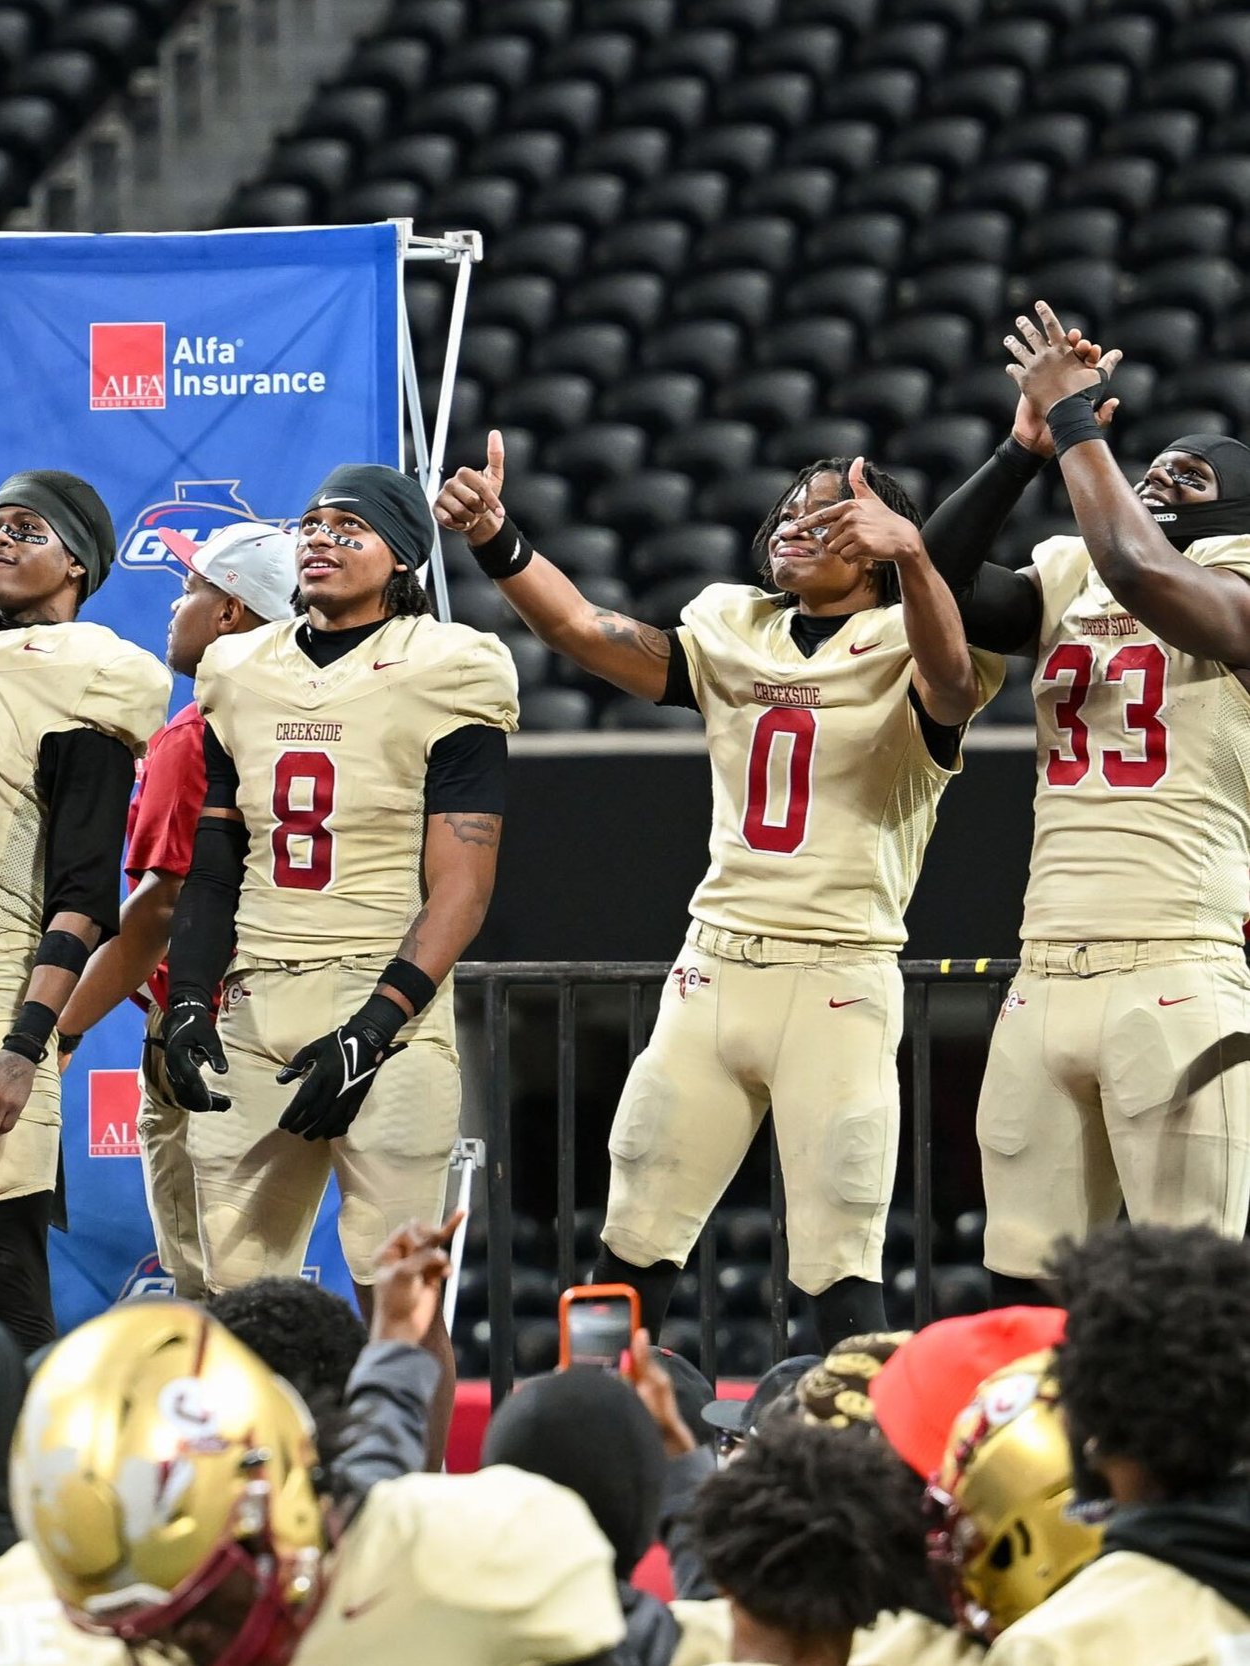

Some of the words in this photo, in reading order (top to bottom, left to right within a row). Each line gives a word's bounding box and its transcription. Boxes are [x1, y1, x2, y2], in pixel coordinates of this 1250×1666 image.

[172, 336, 235, 365] Alfa
[101, 375, 164, 397] ALFA
[173, 368, 326, 396] Insurance
[1082, 616, 1139, 636] CREEKSIDE
[754, 682, 821, 706] CREEKSIDE
[1041, 642, 1168, 789] 33
[276, 722, 342, 742] CREEKSIDE
[741, 706, 818, 856] 0
[271, 749, 337, 893] 8
[100, 1122, 136, 1145] AL
